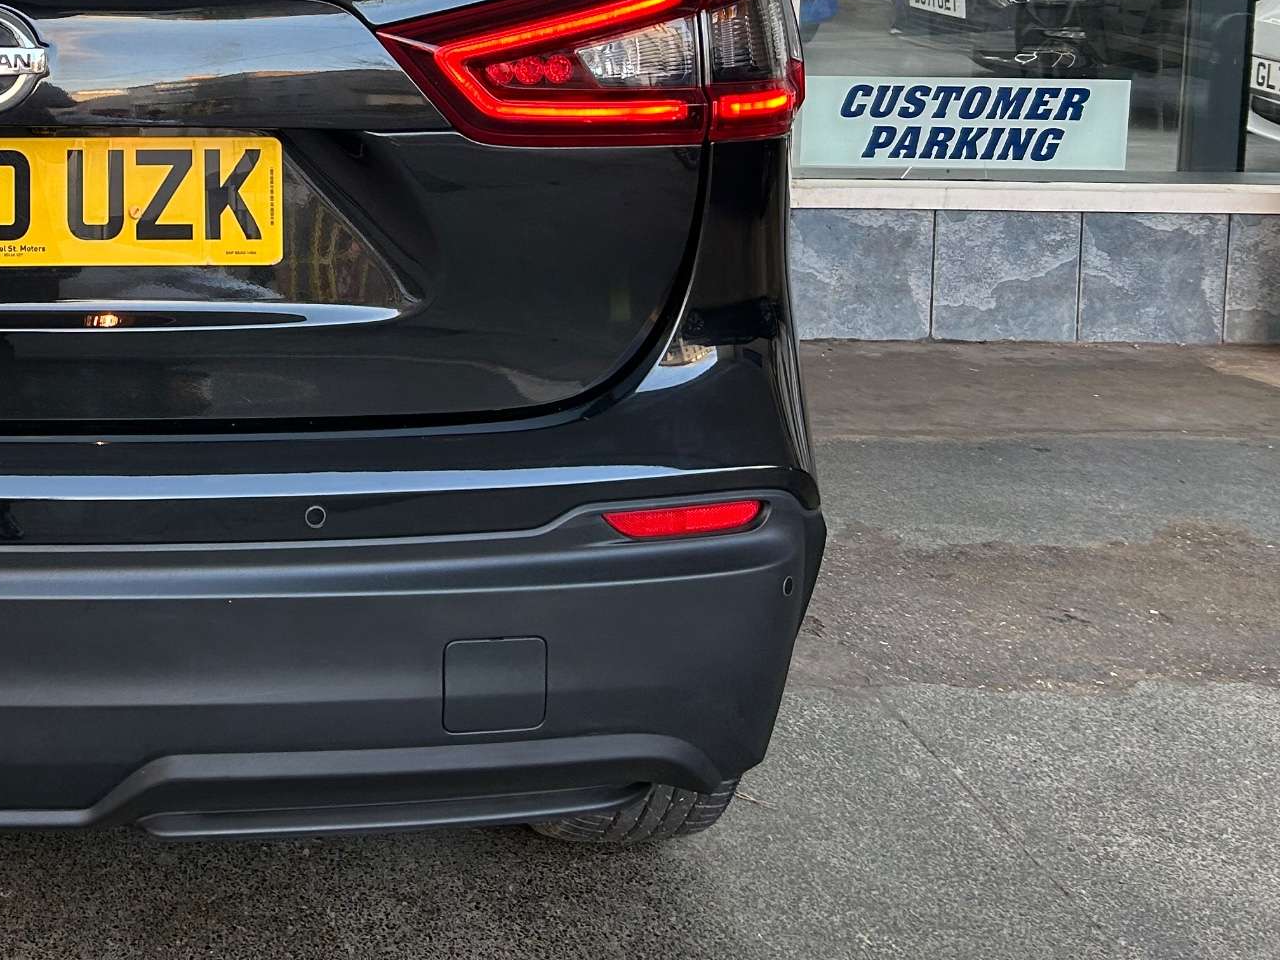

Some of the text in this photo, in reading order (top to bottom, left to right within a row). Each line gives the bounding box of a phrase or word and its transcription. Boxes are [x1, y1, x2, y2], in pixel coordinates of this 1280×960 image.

[1256, 61, 1280, 91] GL
[840, 83, 1091, 122] CUSTOMER
[861, 125, 1065, 162] PARKING
[66, 149, 263, 241] UZK
[20, 244, 46, 252] Motors
